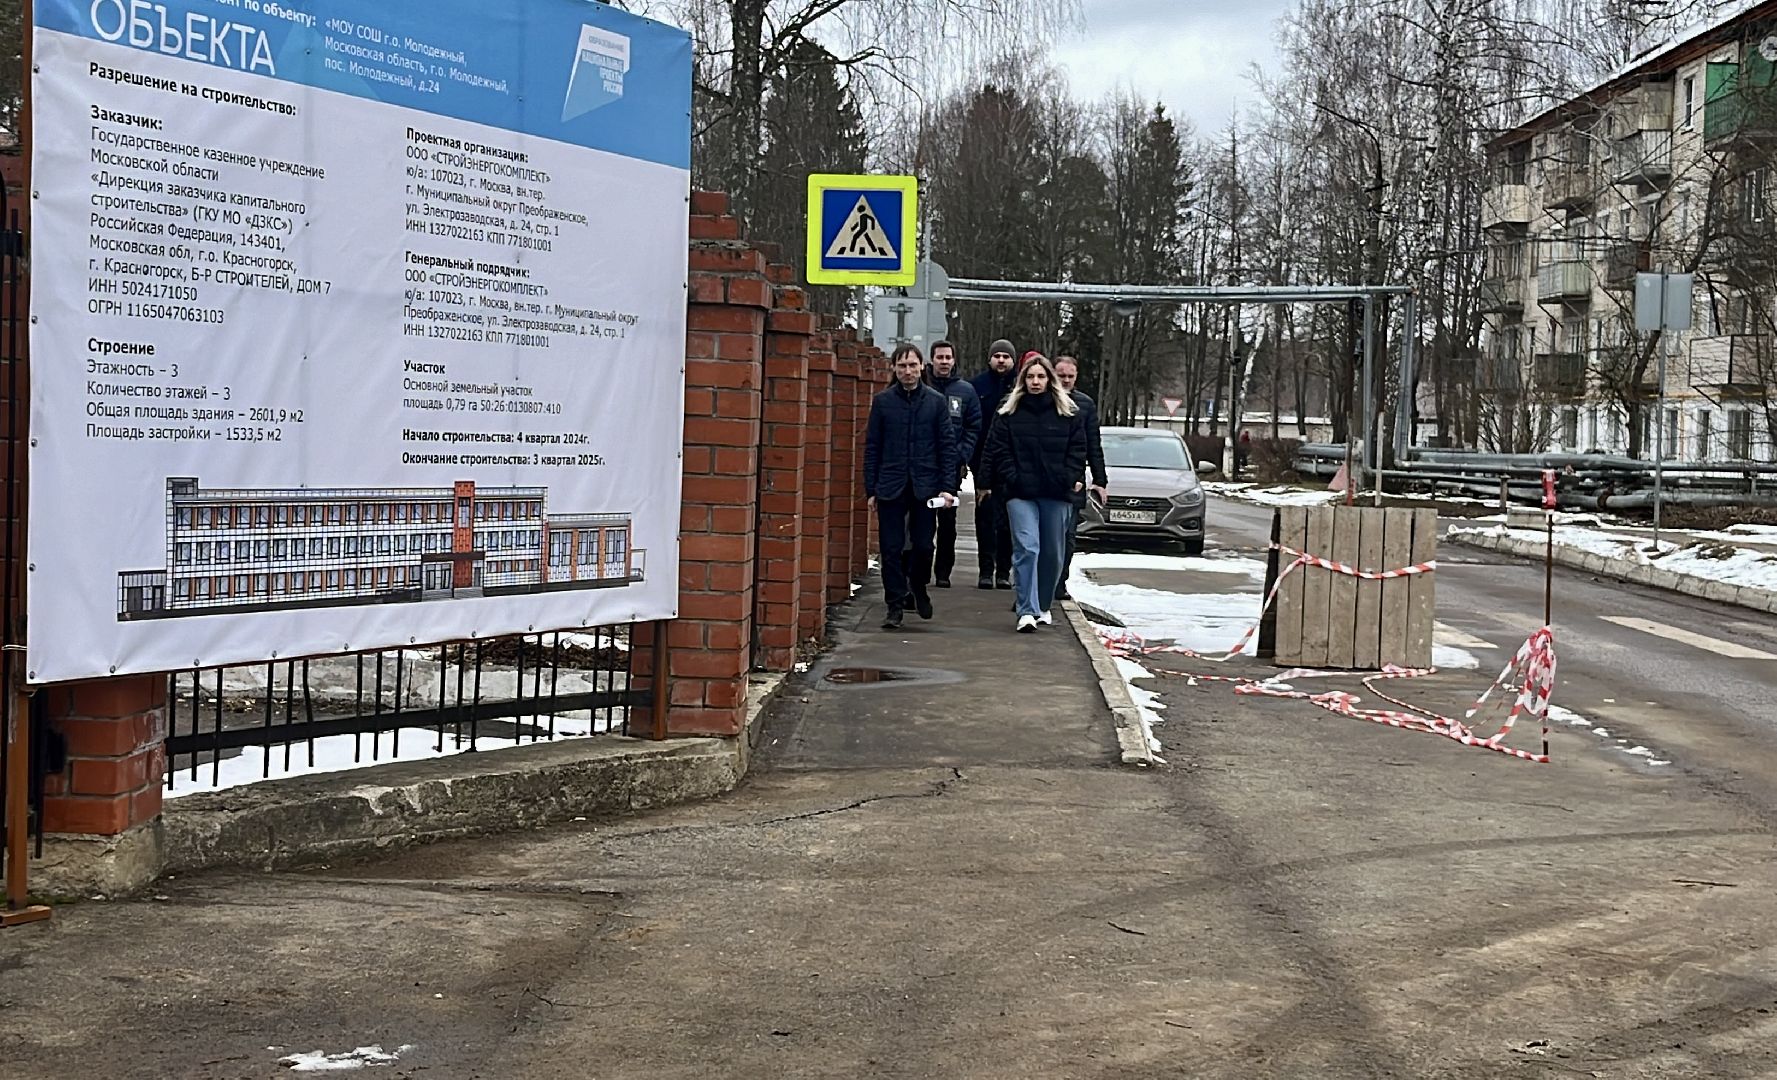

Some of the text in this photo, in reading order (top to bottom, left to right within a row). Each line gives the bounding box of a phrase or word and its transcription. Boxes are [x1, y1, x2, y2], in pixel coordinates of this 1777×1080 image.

[244, 0, 259, 12] по
[263, 3, 316, 27] объекту:
[91, 0, 275, 75] ОБЪЕКТА
[325, 18, 467, 67] «МОУ СОШ г.о. Молодежный,
[325, 36, 509, 95] Московская область, г.о. Молодежный,
[325, 57, 440, 94] пос. Молодежный, д.24
[90, 62, 296, 115] Разрешение на строительство:
[91, 105, 163, 130] Заказчик:
[91, 126, 325, 179] Государственное казенное учреждение
[406, 127, 528, 163] Проектная организация:
[91, 149, 219, 181] Московской области
[406, 145, 550, 183] ООО «СТРОЙЭНЕРГОКОМПЛЕКТ»
[91, 171, 306, 215] «Дирекция заказчика капитального
[406, 165, 545, 201] ю/а: 107023, г. Москва, вн.тер.
[91, 193, 293, 234] строительства» (ГКУ МО «ДЗКС»)
[406, 184, 589, 226] г. Муниципальный округ Преображенское,
[406, 203, 559, 237] ул. Электрозаводская, д. 24, стр. 1
[90, 213, 286, 252] Российская Федерация, 143401,
[405, 219, 552, 251] ИНН 1327022163 КПП 771801001
[90, 235, 297, 274] Московская обл, г.о. Красногорск,
[405, 251, 530, 278] Генеральный подрядчик:
[88, 278, 198, 301] ИНН 5024171050
[89, 258, 331, 295] г. Красногорск, Б-Р СТРОИТЕЛЕЙ, ДОМ 7
[405, 269, 548, 297] ООО «СТРОЙЭНЕРГОКОМПЛЕКТ»
[88, 299, 224, 324] ОГРН 1165047063103
[404, 289, 639, 325] ю/а: 107023, г. Москва, вн.тер. г. Муниципальный округ
[404, 305, 625, 339] Преображенское, ул. Электрозаводская, д. 24, стр. 1
[88, 338, 155, 356] Строение
[404, 324, 549, 347] ИНН 1327022163 КПП 771801001
[87, 359, 154, 376] Этажность
[171, 364, 178, 377] 3
[404, 359, 445, 374] Участок
[87, 381, 161, 398] Количество
[165, 386, 207, 400] этажей
[223, 387, 231, 400] 3
[403, 378, 533, 397] Основной земельный участок
[86, 401, 130, 419] Общая
[134, 405, 188, 420] площадь
[192, 408, 234, 421] здания
[250, 407, 286, 424] 2601,9
[290, 409, 304, 422] м2
[403, 398, 561, 414] площадь 0,79 га 50:26:0130807:410
[86, 424, 144, 439] Площадь
[148, 425, 210, 442] застройки
[226, 427, 264, 443] 1533,5
[267, 428, 281, 441] м2
[402, 429, 590, 446] Начало строительства: 4 квартал 2024г.
[402, 452, 605, 466] Окончание строительства: 3 квартал 2025г.
